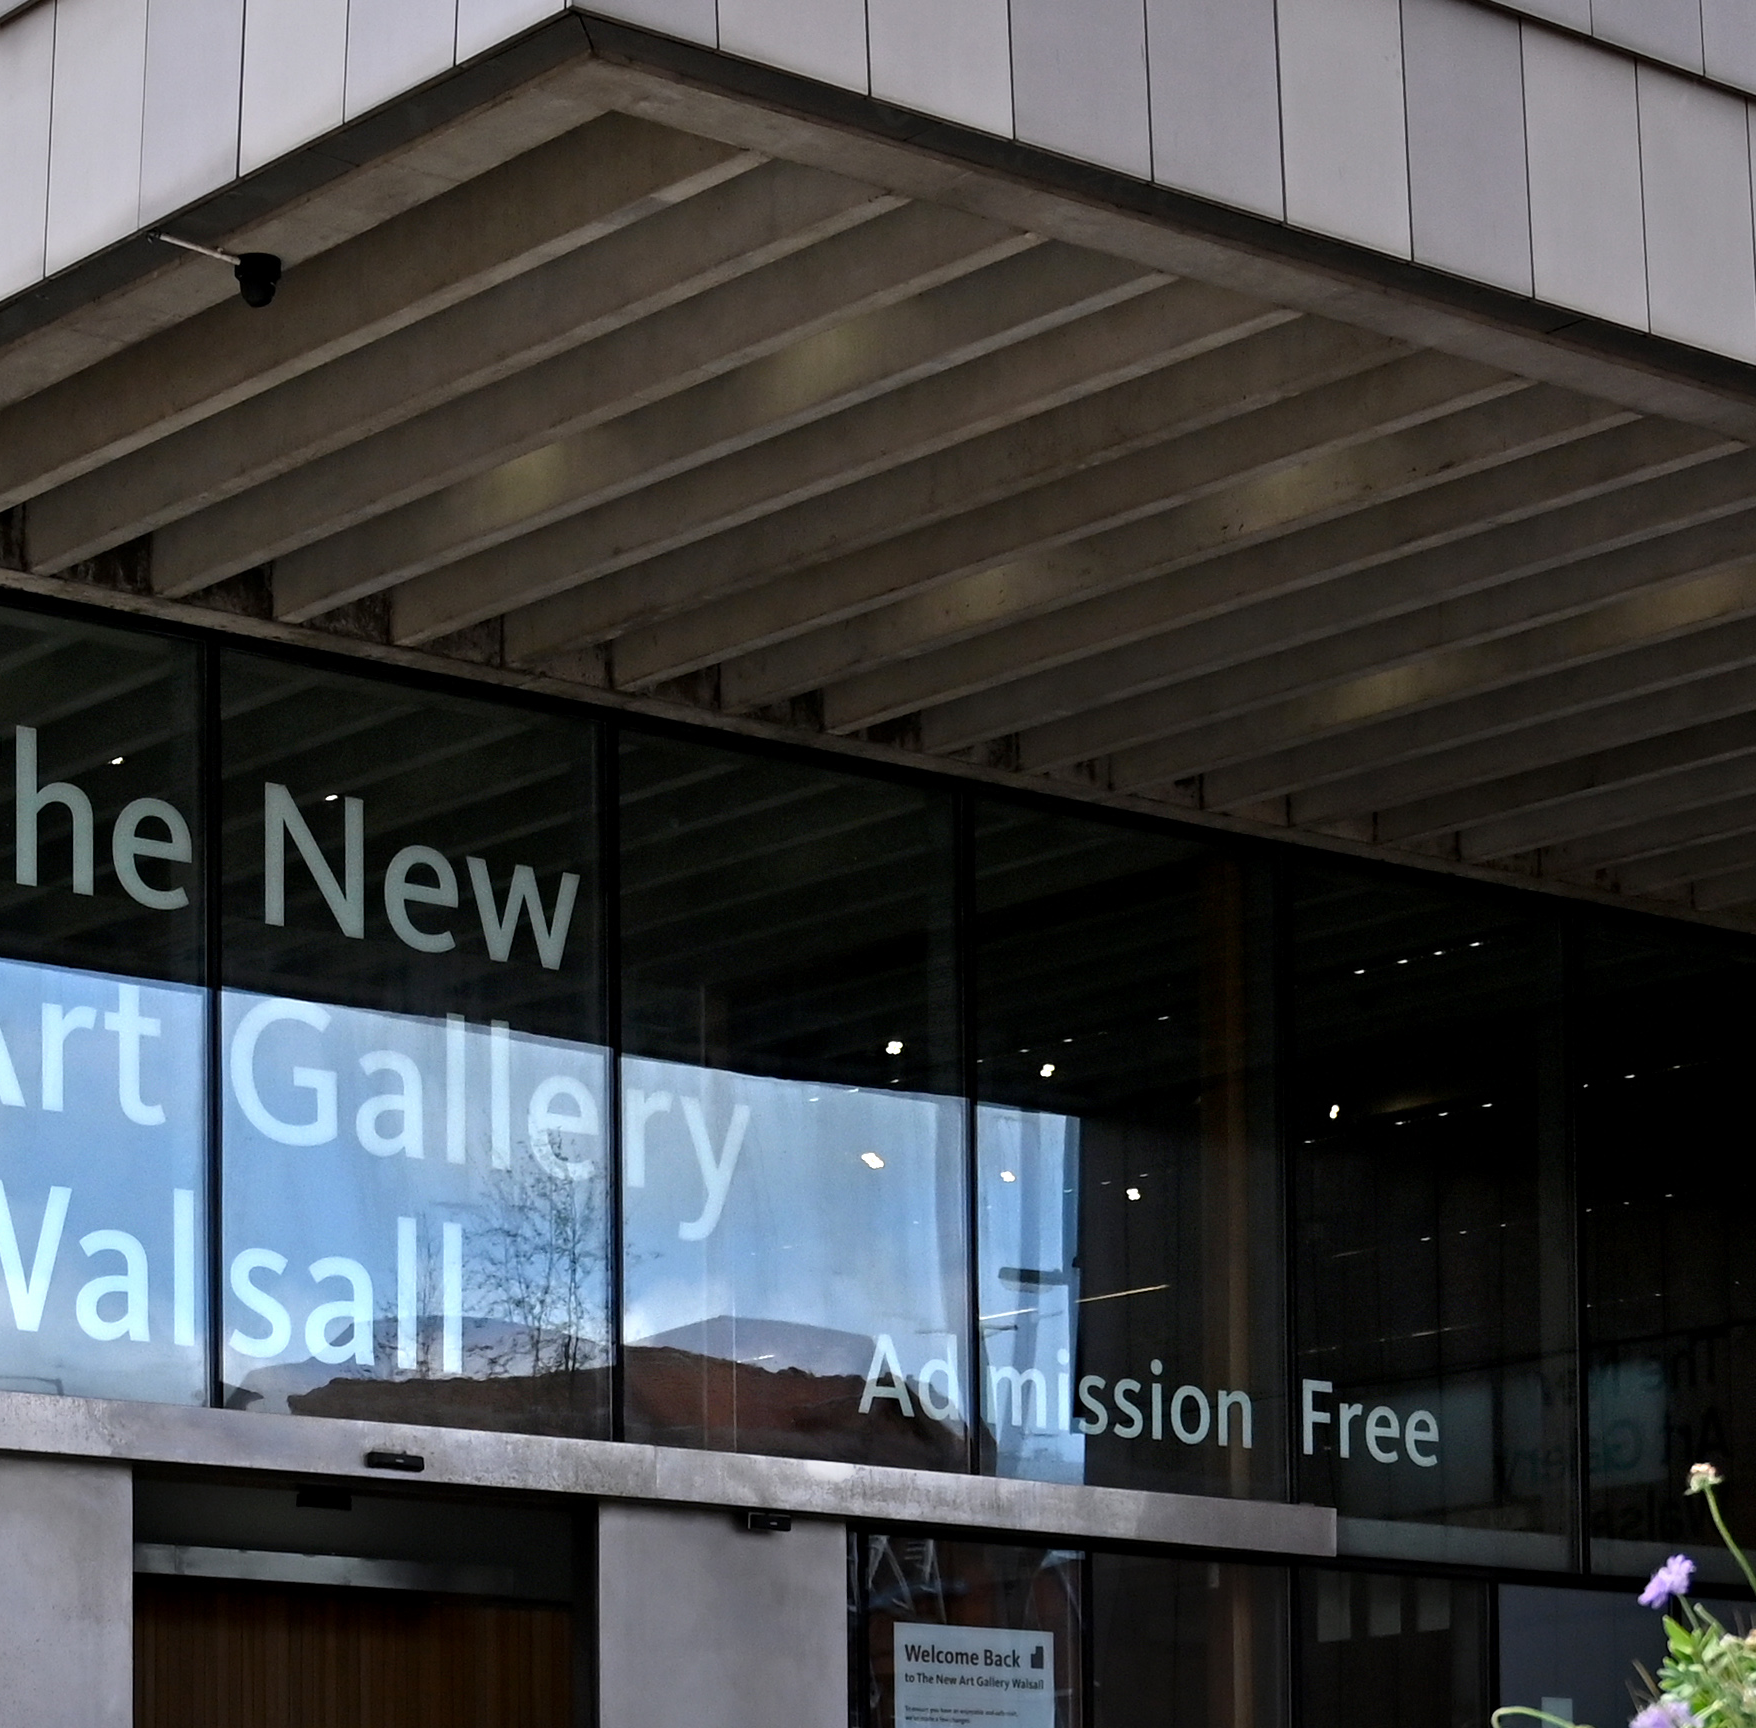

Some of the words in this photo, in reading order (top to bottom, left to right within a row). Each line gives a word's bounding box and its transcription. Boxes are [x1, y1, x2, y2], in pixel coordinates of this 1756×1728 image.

[264, 781, 580, 971] New
[229, 1001, 751, 1242] Gallery
[858, 1333, 1253, 1451] Admission
[1301, 1378, 1441, 1468] Free
[904, 1644, 980, 1666] Welcome
[983, 1648, 1021, 1669] Back
[904, 1673, 915, 1683] to
[917, 1673, 934, 1685] The
[936, 1674, 957, 1686] New
[959, 1675, 975, 1687] Art
[976, 1676, 1010, 1692] Gallery
[1012, 1678, 1045, 1690] Walsall
